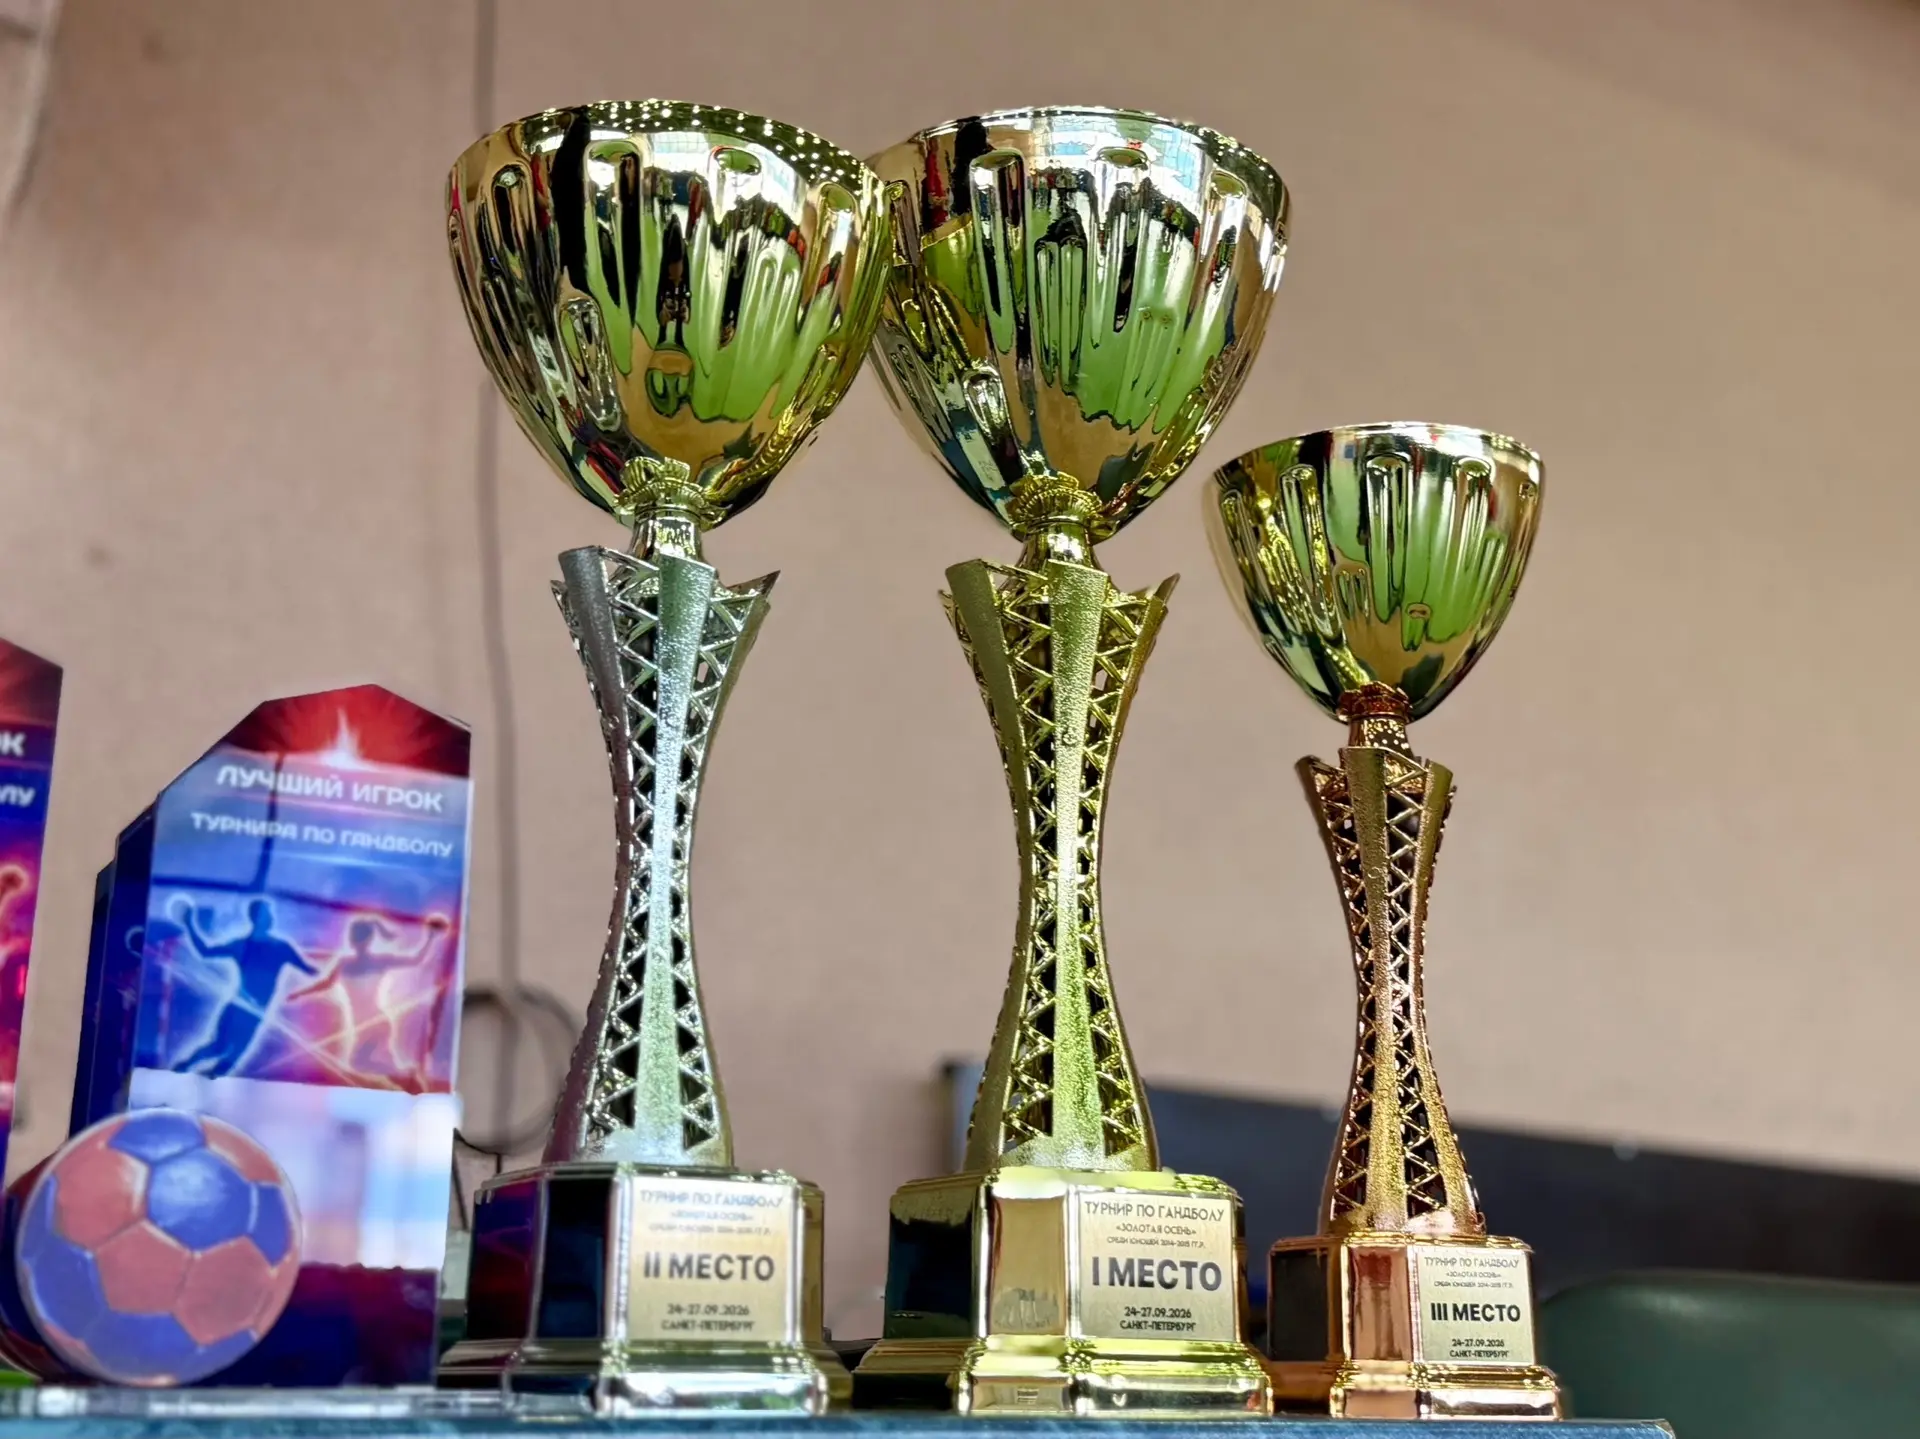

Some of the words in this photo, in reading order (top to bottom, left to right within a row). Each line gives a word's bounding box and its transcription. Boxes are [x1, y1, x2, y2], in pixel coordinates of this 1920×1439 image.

[216, 765, 343, 799] ЛУЧШИЙ
[351, 782, 444, 813] ИГРОК
[190, 811, 297, 839] ТУРНИРА
[303, 824, 335, 845] ПО
[340, 829, 454, 858] ГАНДБОЛУ
[692, 1191, 711, 1205] ПО
[1085, 1200, 1134, 1217] ТУРНИР
[1136, 1203, 1155, 1218] ПО
[1158, 1205, 1225, 1222] ГАНДБОЛУ
[1116, 1223, 1163, 1234] «ЗОЛОТАЯ
[1163, 1226, 1197, 1236] ОСЕНЬ»
[644, 1251, 661, 1279] II
[668, 1252, 775, 1281] МЕСТО
[1424, 1256, 1457, 1266] ТУРНИР
[1459, 1256, 1472, 1267] ПО
[1474, 1258, 1519, 1268] ГАНДБОЛУ
[1092, 1256, 1100, 1286] I
[1108, 1256, 1222, 1292] МЕСТО
[1124, 1306, 1192, 1319] 24-27.09.2026
[1430, 1302, 1448, 1321] III
[1452, 1302, 1521, 1322] МЕСТО
[661, 1319, 756, 1332] САНКТ-ПЕТЕРБУРГ
[1119, 1319, 1197, 1332] САНКТ-ПЕТЕРБУРГ
[1449, 1349, 1510, 1358] САНКТ-ПЕТЕРБУРГ
